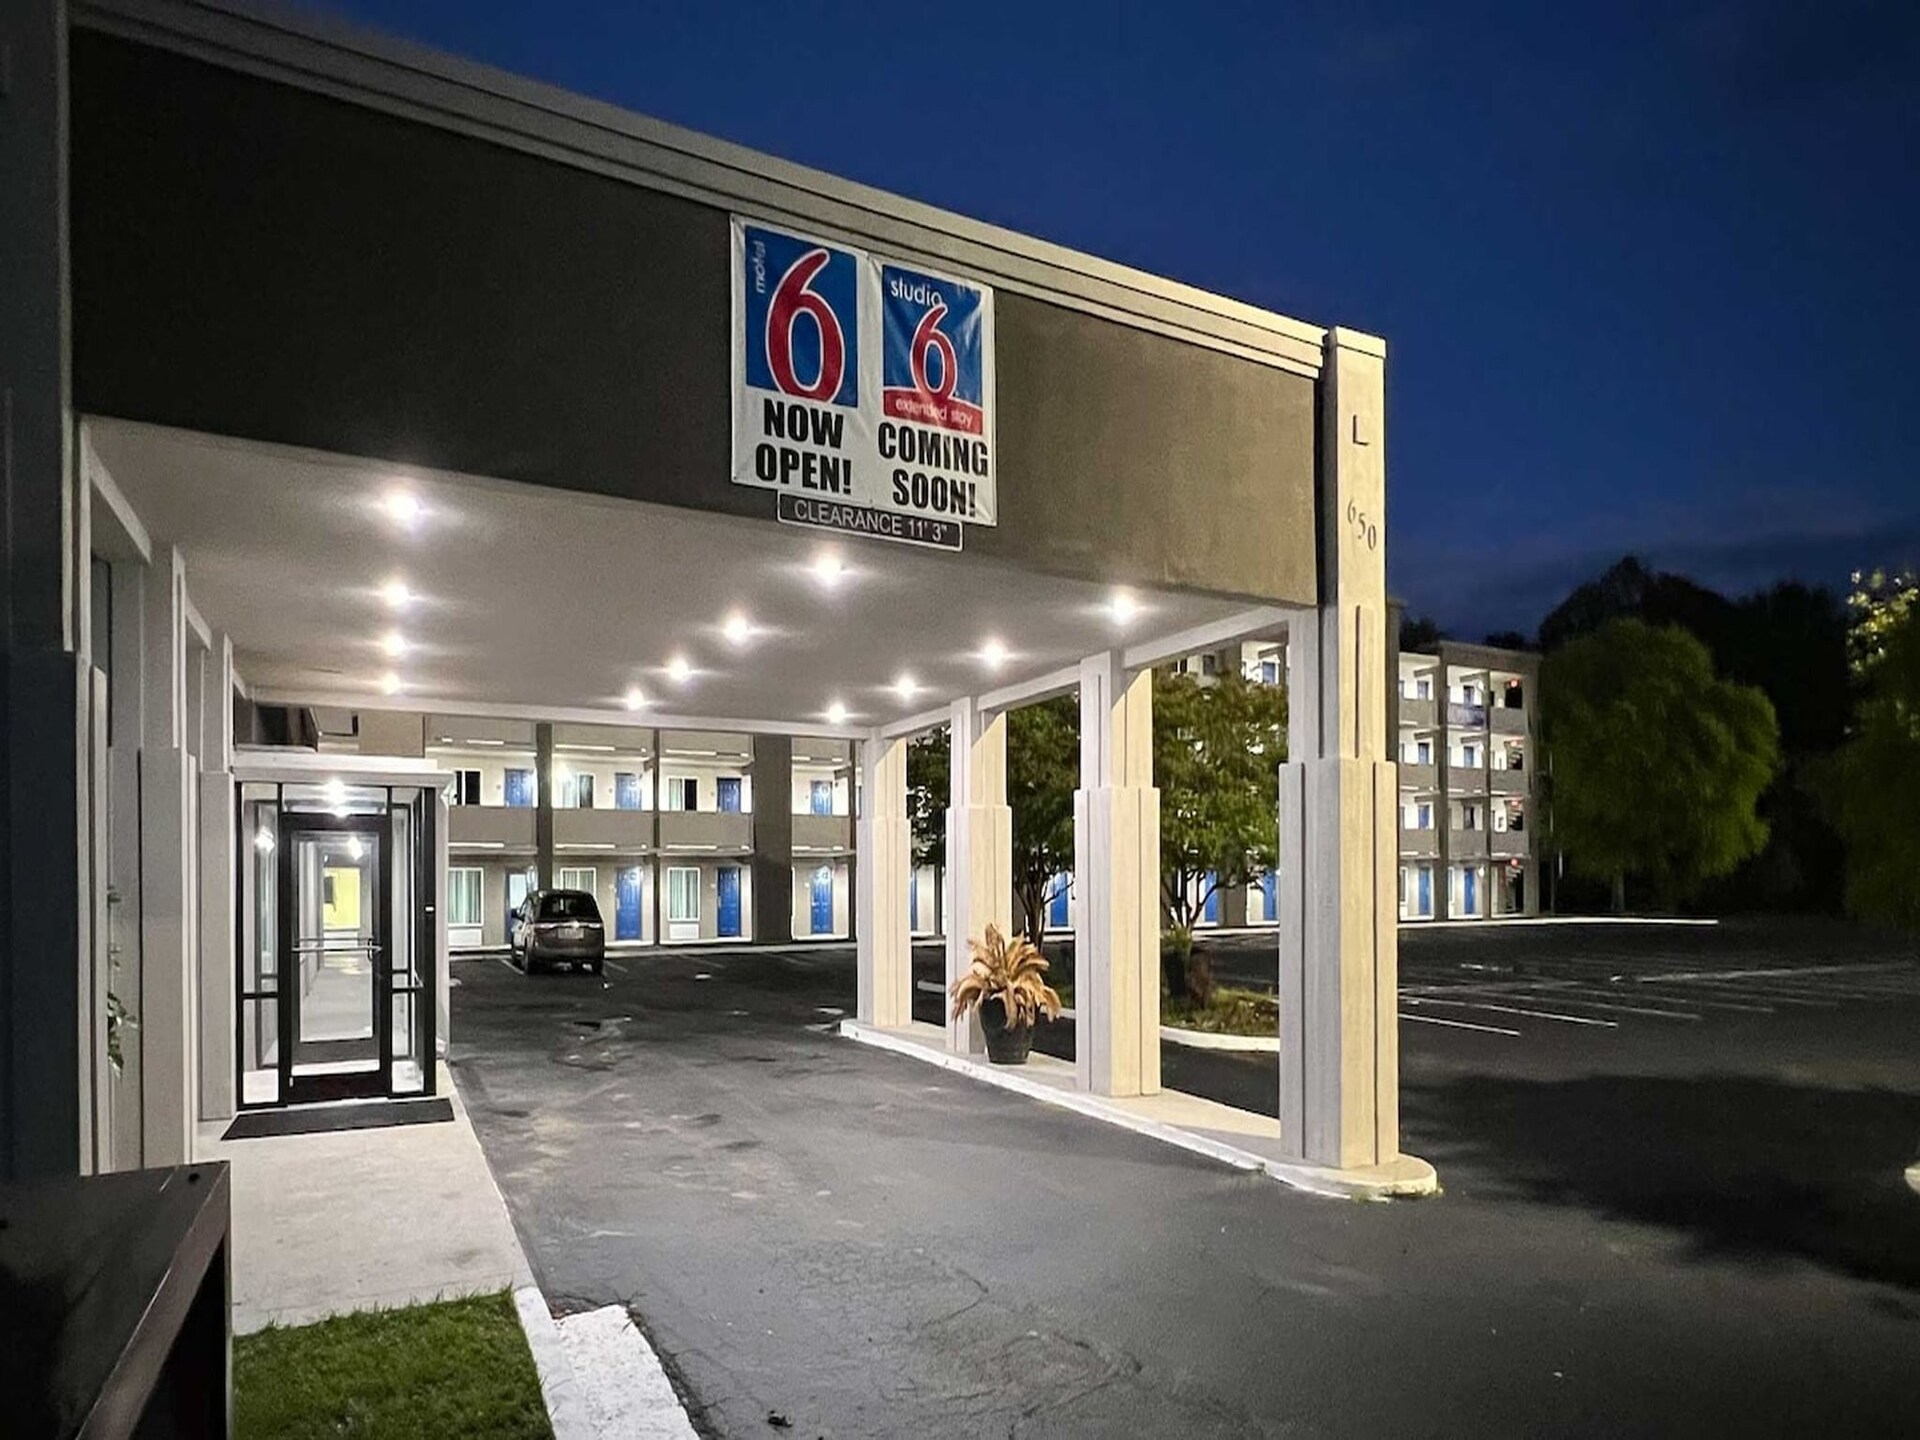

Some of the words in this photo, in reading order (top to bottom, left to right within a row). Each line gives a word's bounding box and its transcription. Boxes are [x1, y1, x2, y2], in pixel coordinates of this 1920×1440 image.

[753, 241, 766, 294] motel
[890, 278, 943, 307] studio
[765, 248, 846, 404] 6
[910, 303, 958, 403] 6
[763, 398, 844, 449] NOW
[895, 398, 948, 421] extended
[755, 443, 852, 495] OPEN!
[878, 422, 988, 477] COMING
[794, 502, 903, 534] CLEARANCE
[892, 469, 976, 517] SOON!
[1347, 498, 1377, 551] 650
